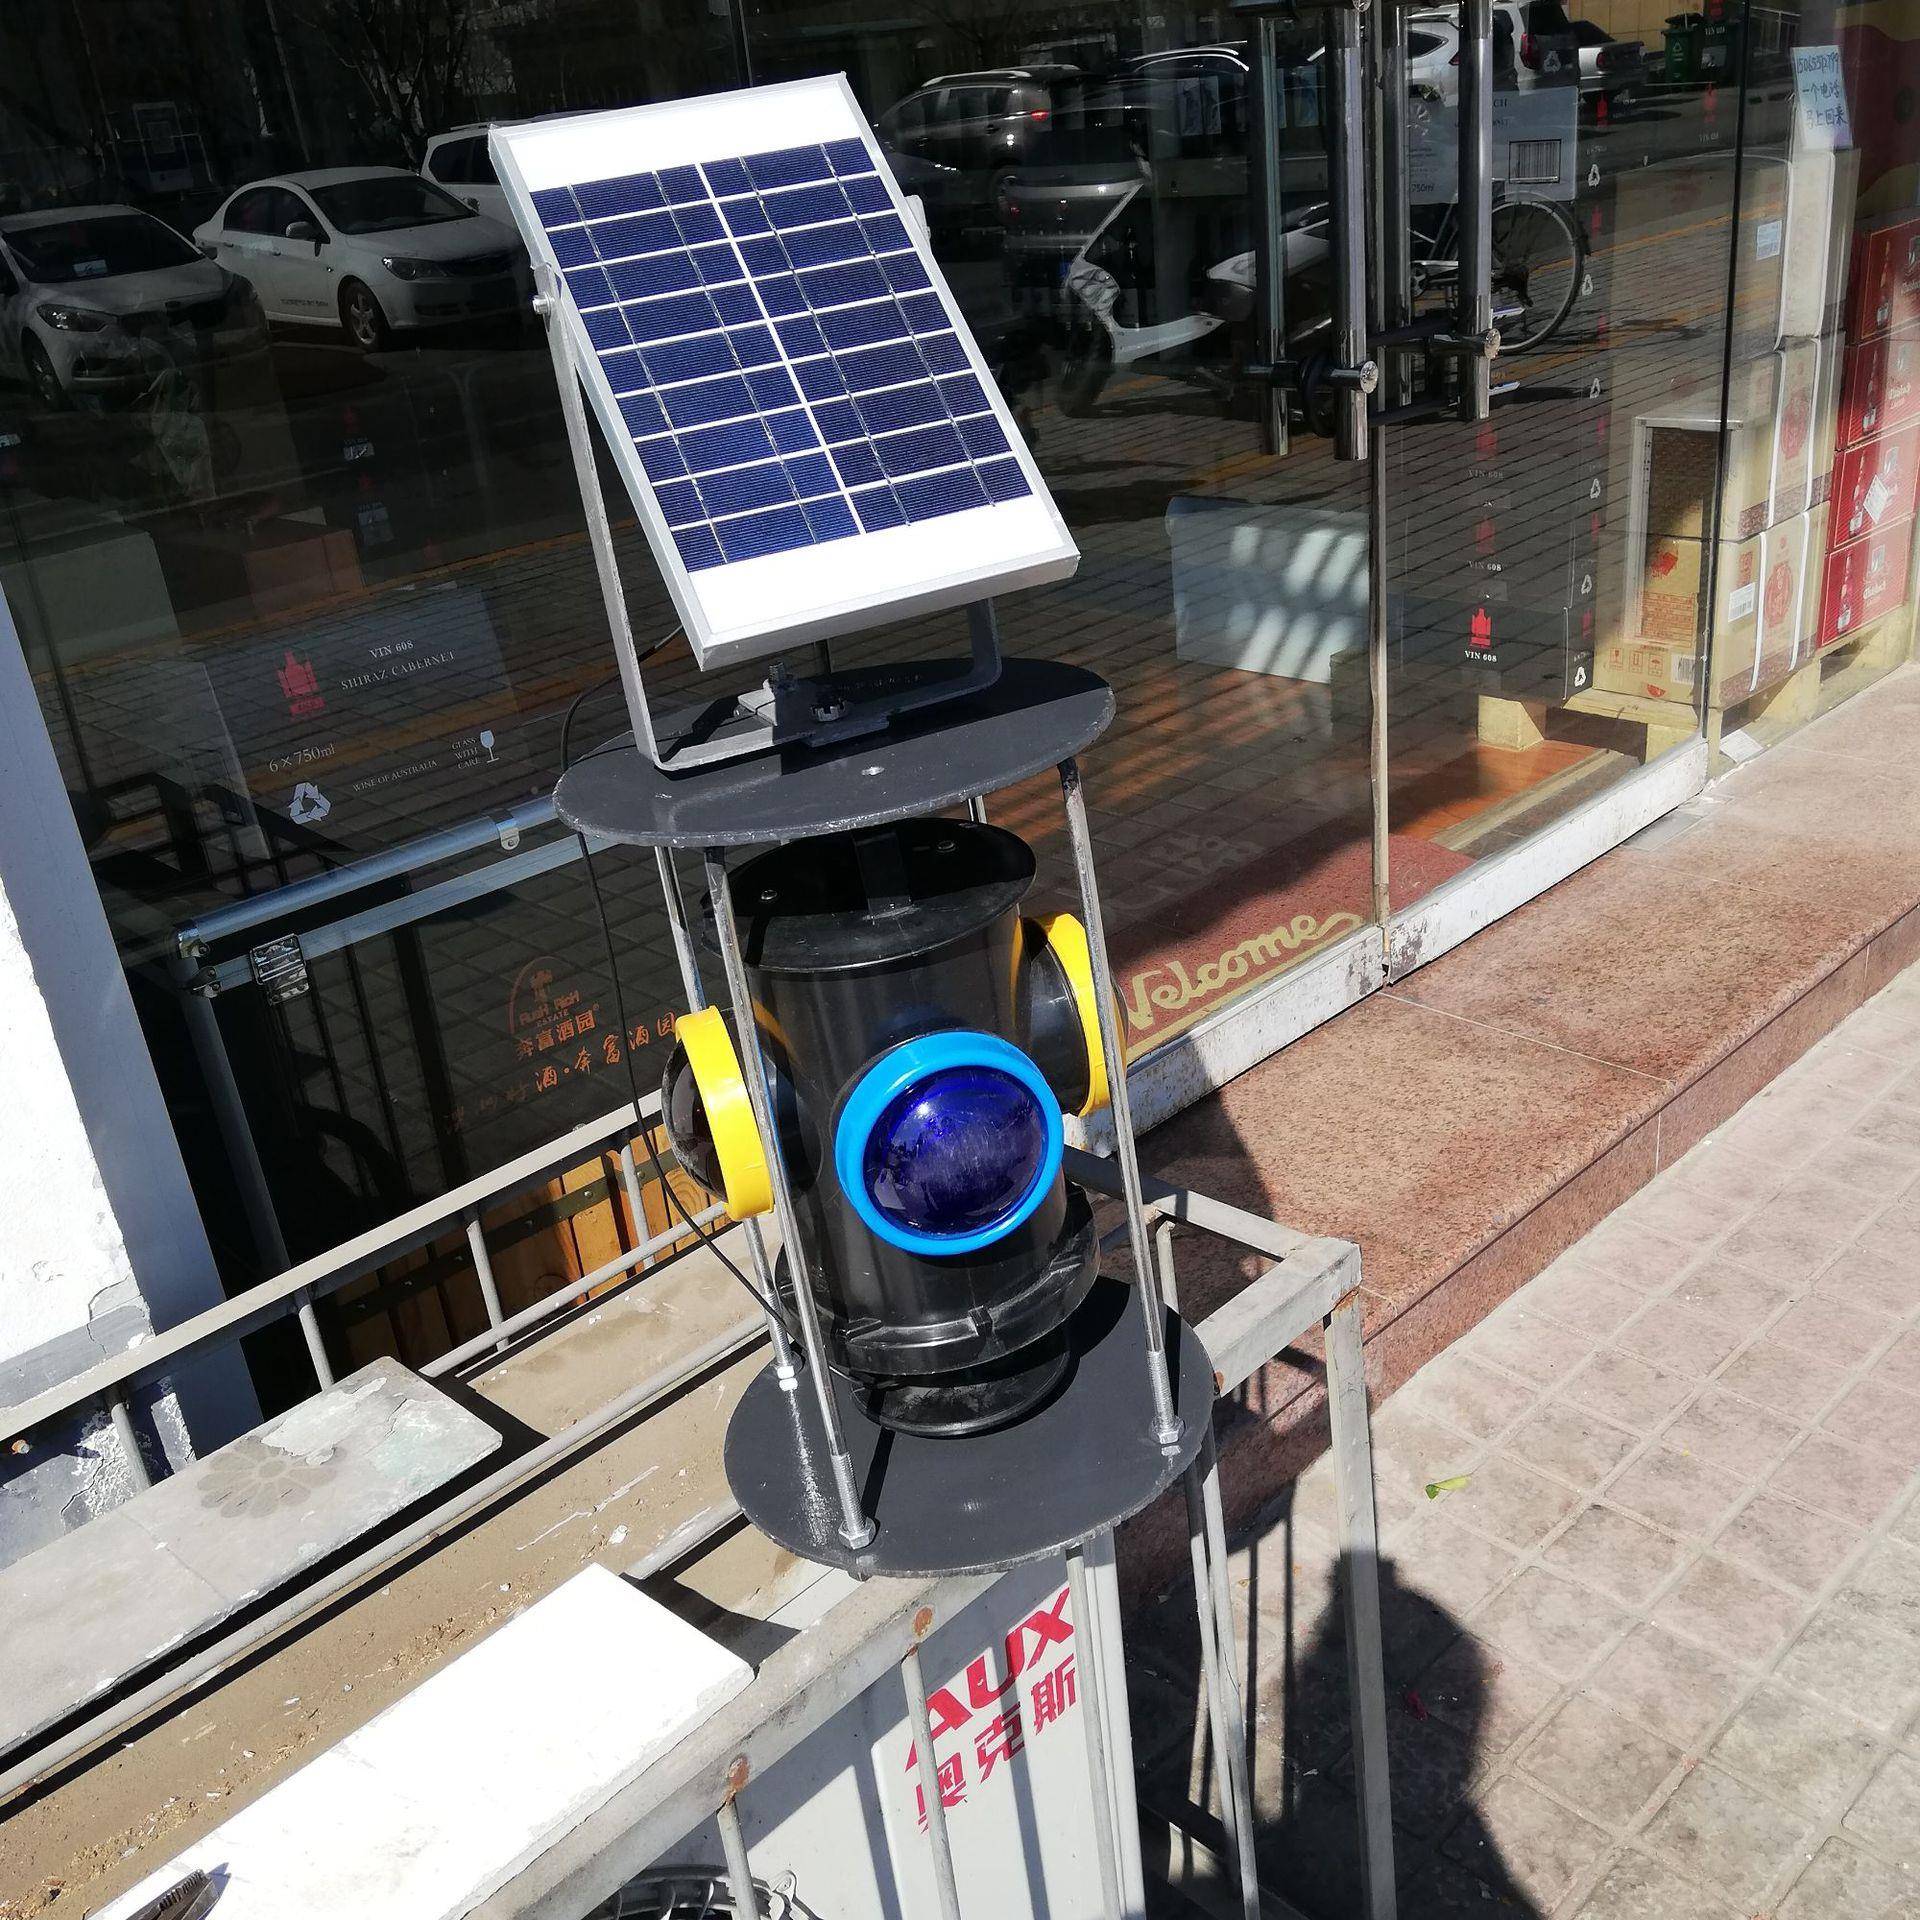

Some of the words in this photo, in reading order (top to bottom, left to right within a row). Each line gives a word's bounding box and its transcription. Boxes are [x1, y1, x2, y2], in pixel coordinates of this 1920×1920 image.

[370, 645, 392, 659] VIN
[395, 640, 414, 653] 608
[1464, 650, 1481, 661] VIN
[1482, 653, 1498, 663] 608
[341, 669, 389, 690] SHIRAZ
[391, 650, 455, 676] CABERNET
[454, 747, 479, 761] WITH
[457, 757, 481, 770] CARE
[353, 776, 376, 793] WINE
[391, 758, 439, 781] AUSTRALIA
[905, 1587, 1075, 1773] AUX
